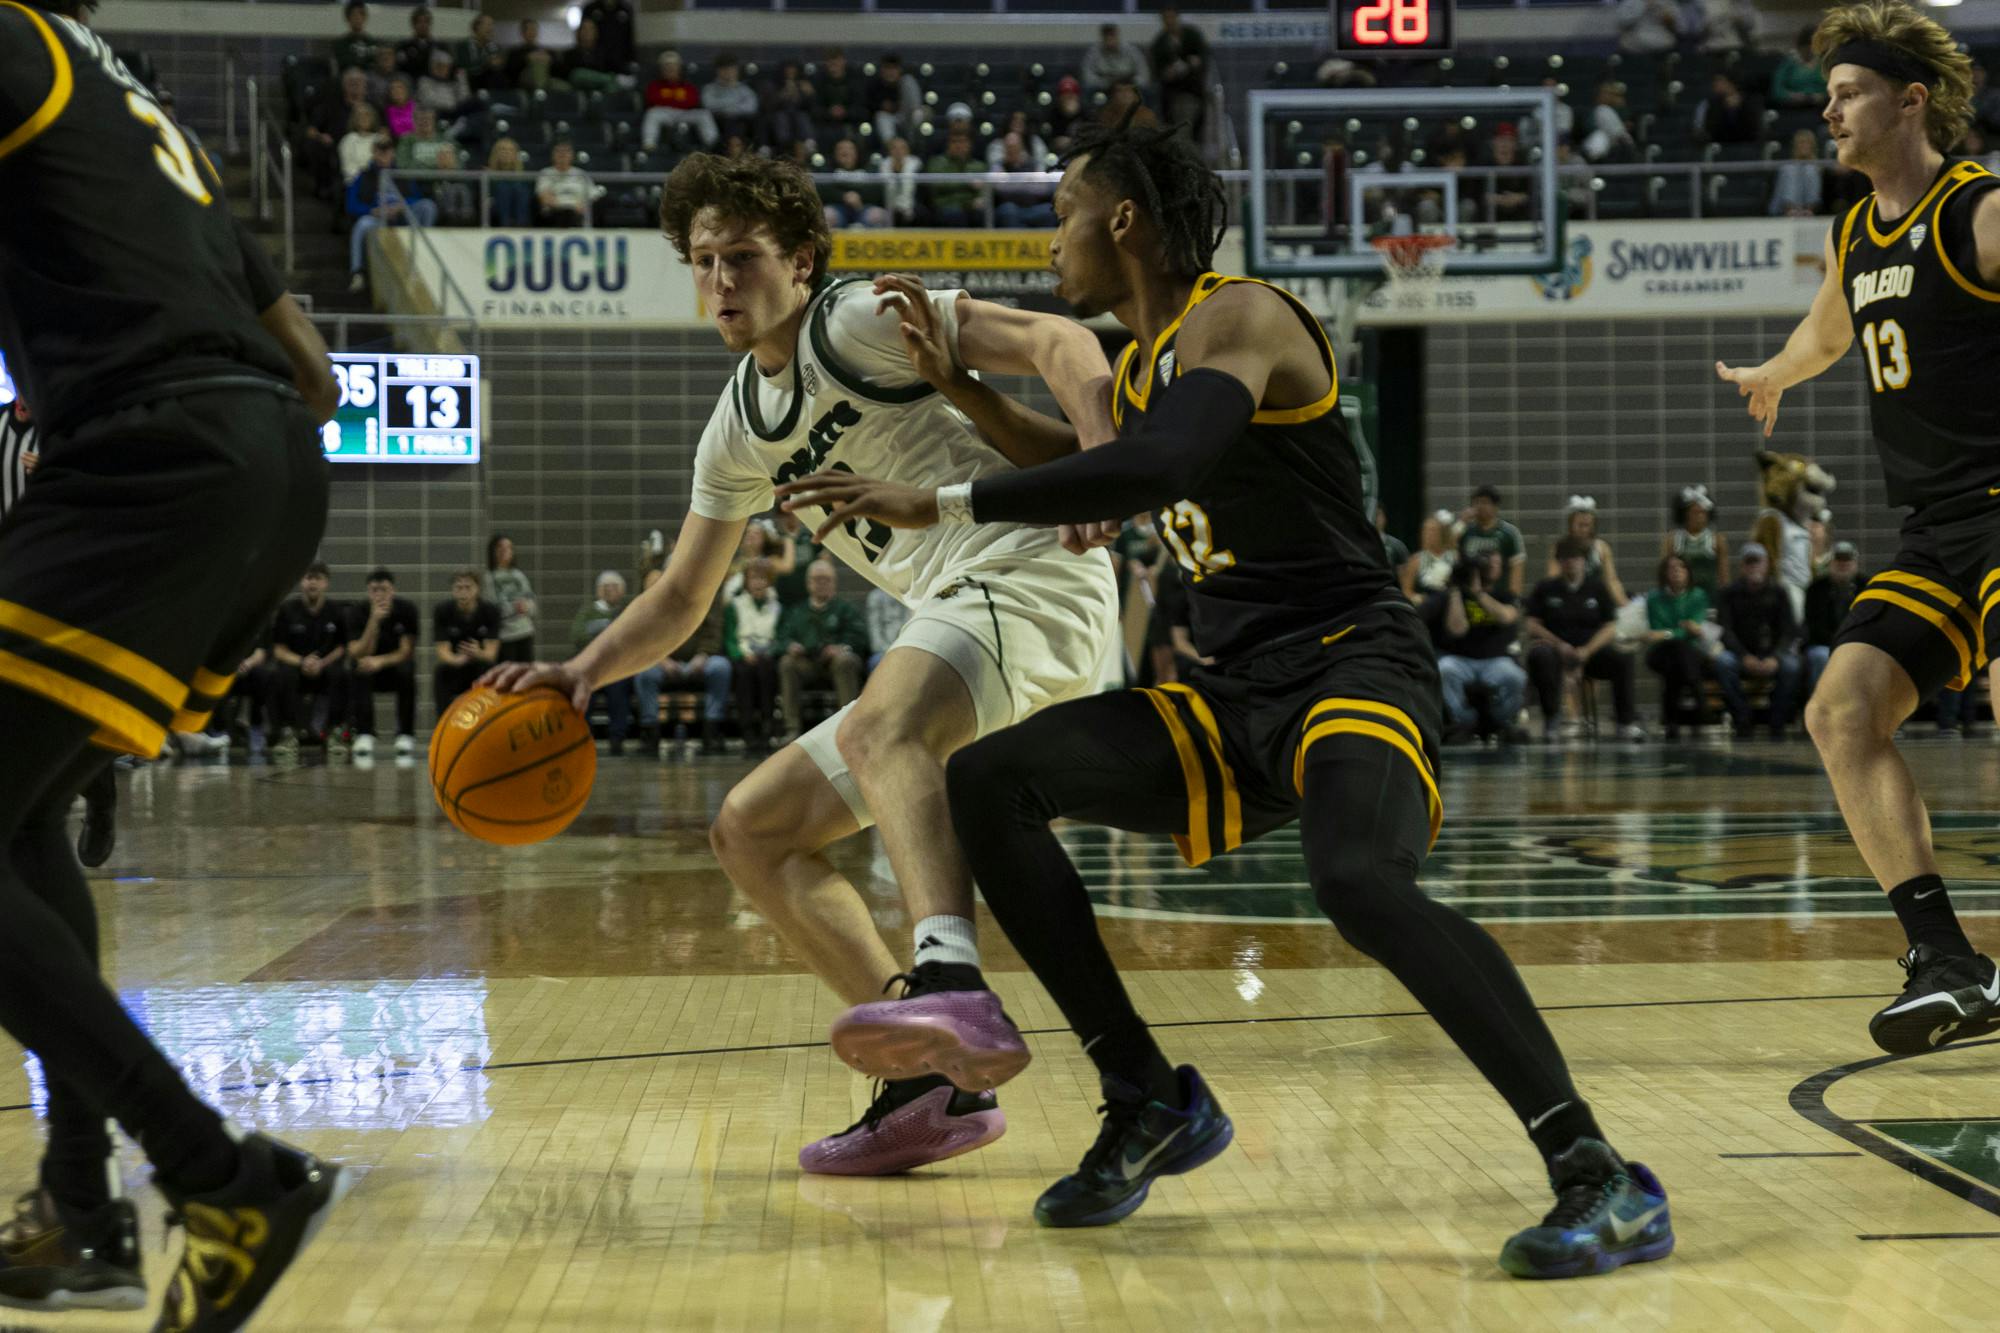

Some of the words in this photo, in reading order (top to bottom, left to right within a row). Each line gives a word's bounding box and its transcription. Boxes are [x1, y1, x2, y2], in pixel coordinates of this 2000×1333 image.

[1353, 0, 1428, 44] 28
[485, 235, 628, 293] OUCU
[845, 239, 945, 259] BOBCAT
[1606, 238, 1781, 281] SNOWVILLE
[1645, 278, 1743, 294] CREAMERY
[1852, 264, 1915, 313] TOLEDO
[483, 301, 627, 316] FINANCIAL
[1863, 318, 1912, 392] 13
[406, 385, 460, 428] 13
[1160, 499, 1236, 582] 12
